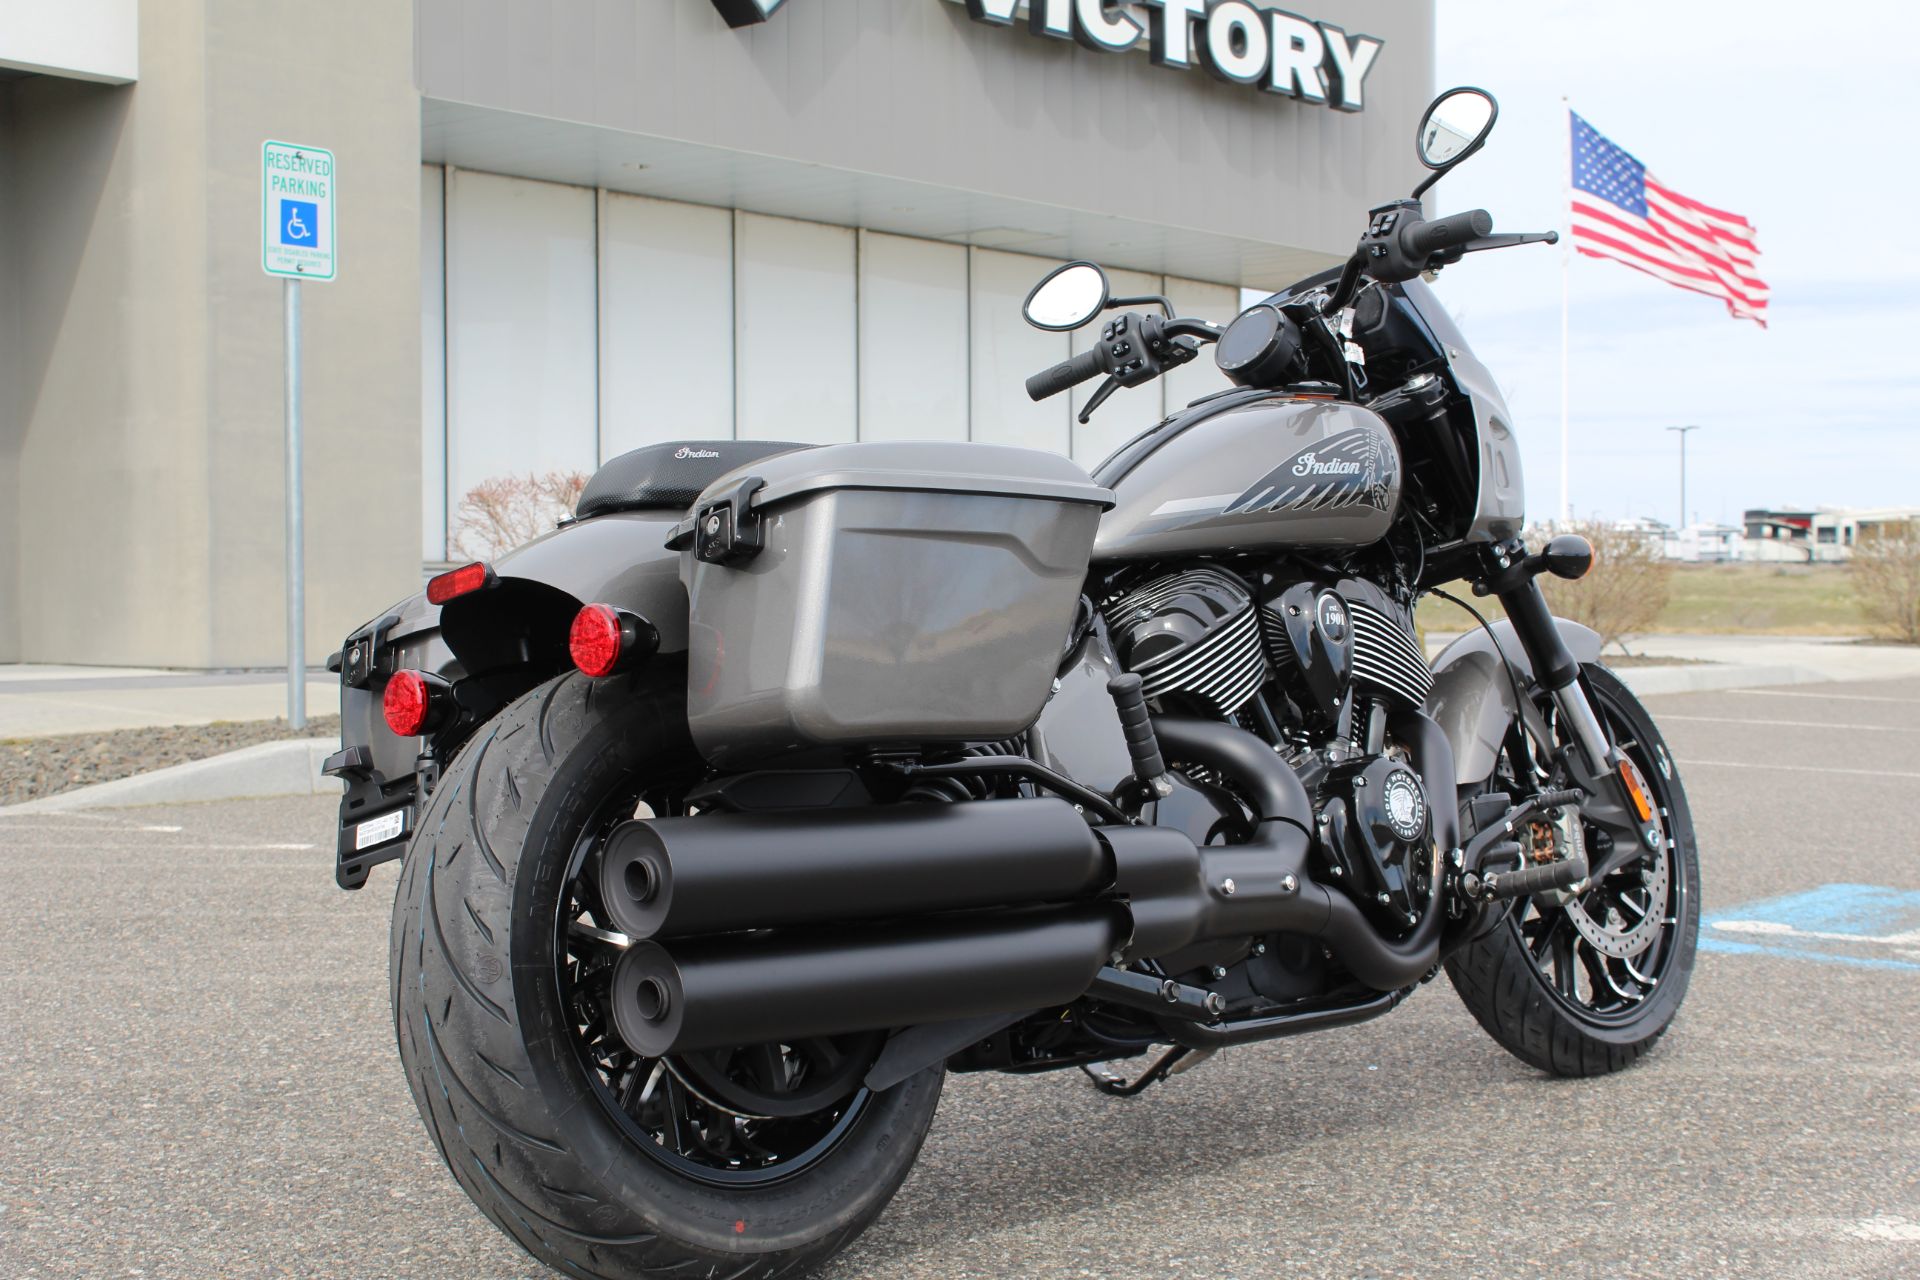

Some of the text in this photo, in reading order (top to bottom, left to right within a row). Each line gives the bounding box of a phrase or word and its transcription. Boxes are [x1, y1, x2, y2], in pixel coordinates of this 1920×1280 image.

[267, 152, 330, 177] RESERVED
[272, 175, 326, 198] PARKING
[674, 447, 720, 459] Indian
[1291, 452, 1360, 476] Indian
[1325, 612, 1345, 626] 1901
[1384, 774, 1423, 825] INDIAN MOTORCYCLE
